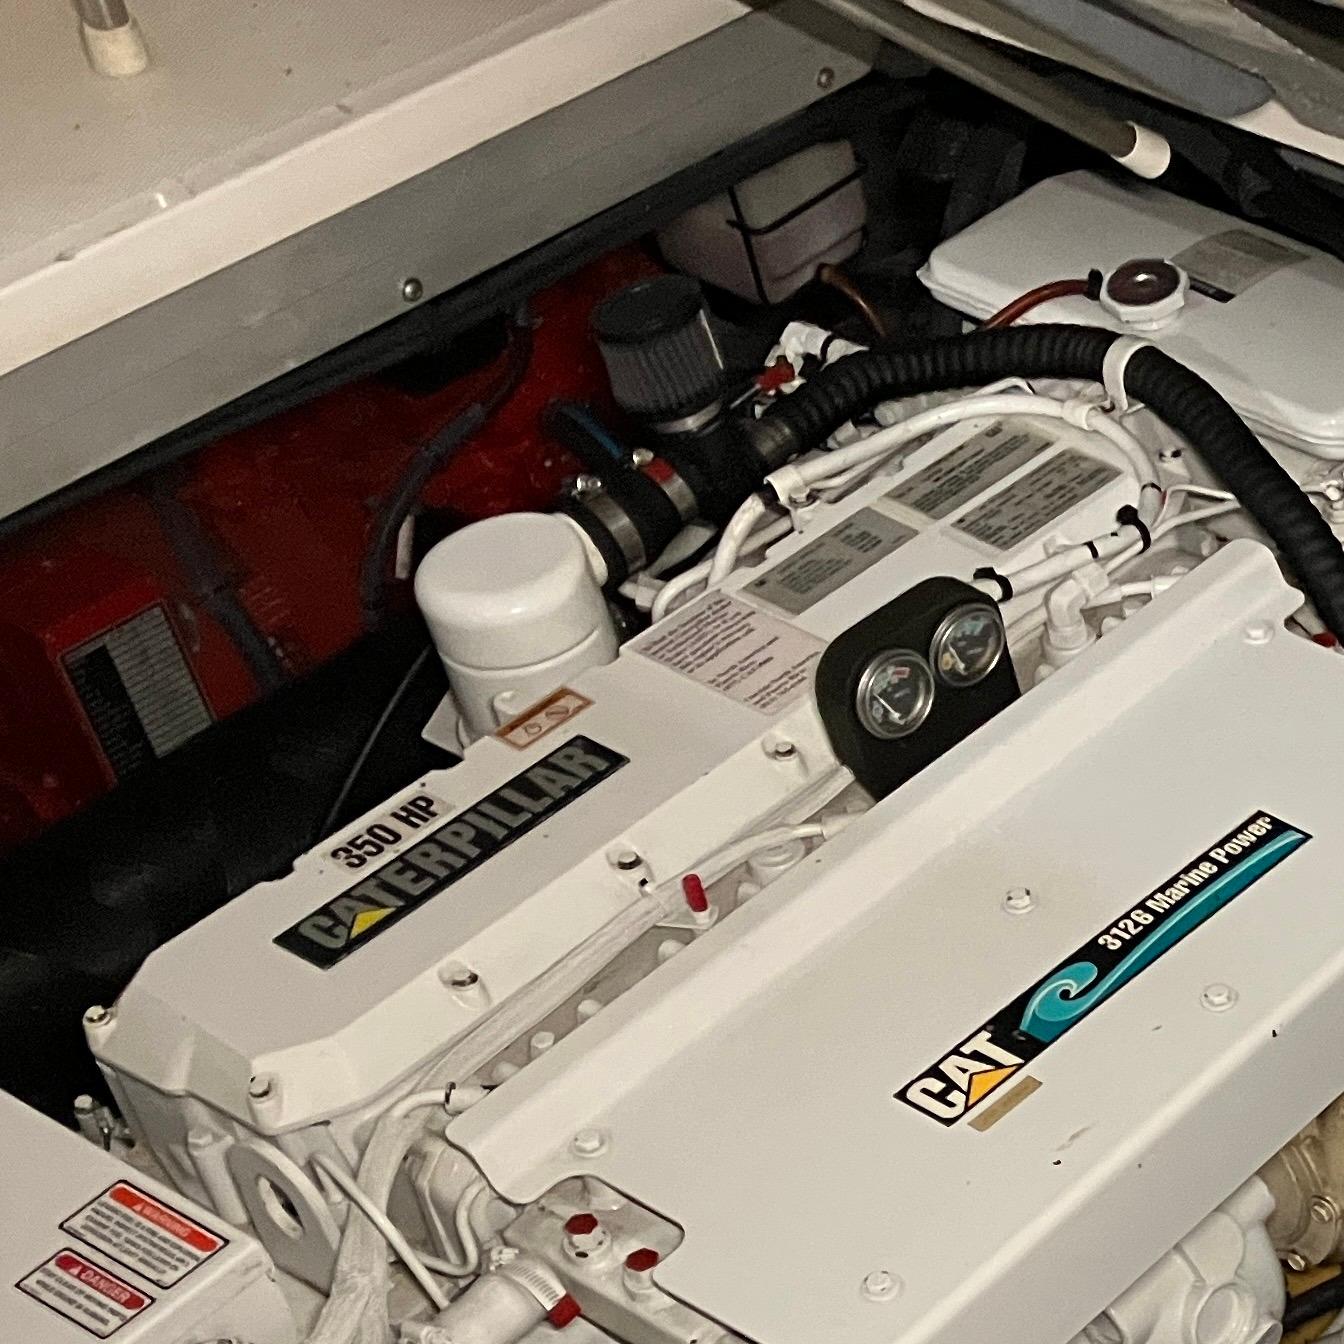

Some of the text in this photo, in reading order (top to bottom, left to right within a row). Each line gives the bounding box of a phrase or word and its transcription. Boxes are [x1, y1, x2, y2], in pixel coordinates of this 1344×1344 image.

[300, 745, 611, 949] CATERPILLAR
[331, 795, 438, 869] 350 HP
[1098, 816, 1272, 950] 3126 Marine Power
[906, 1031, 1025, 1119] CAT
